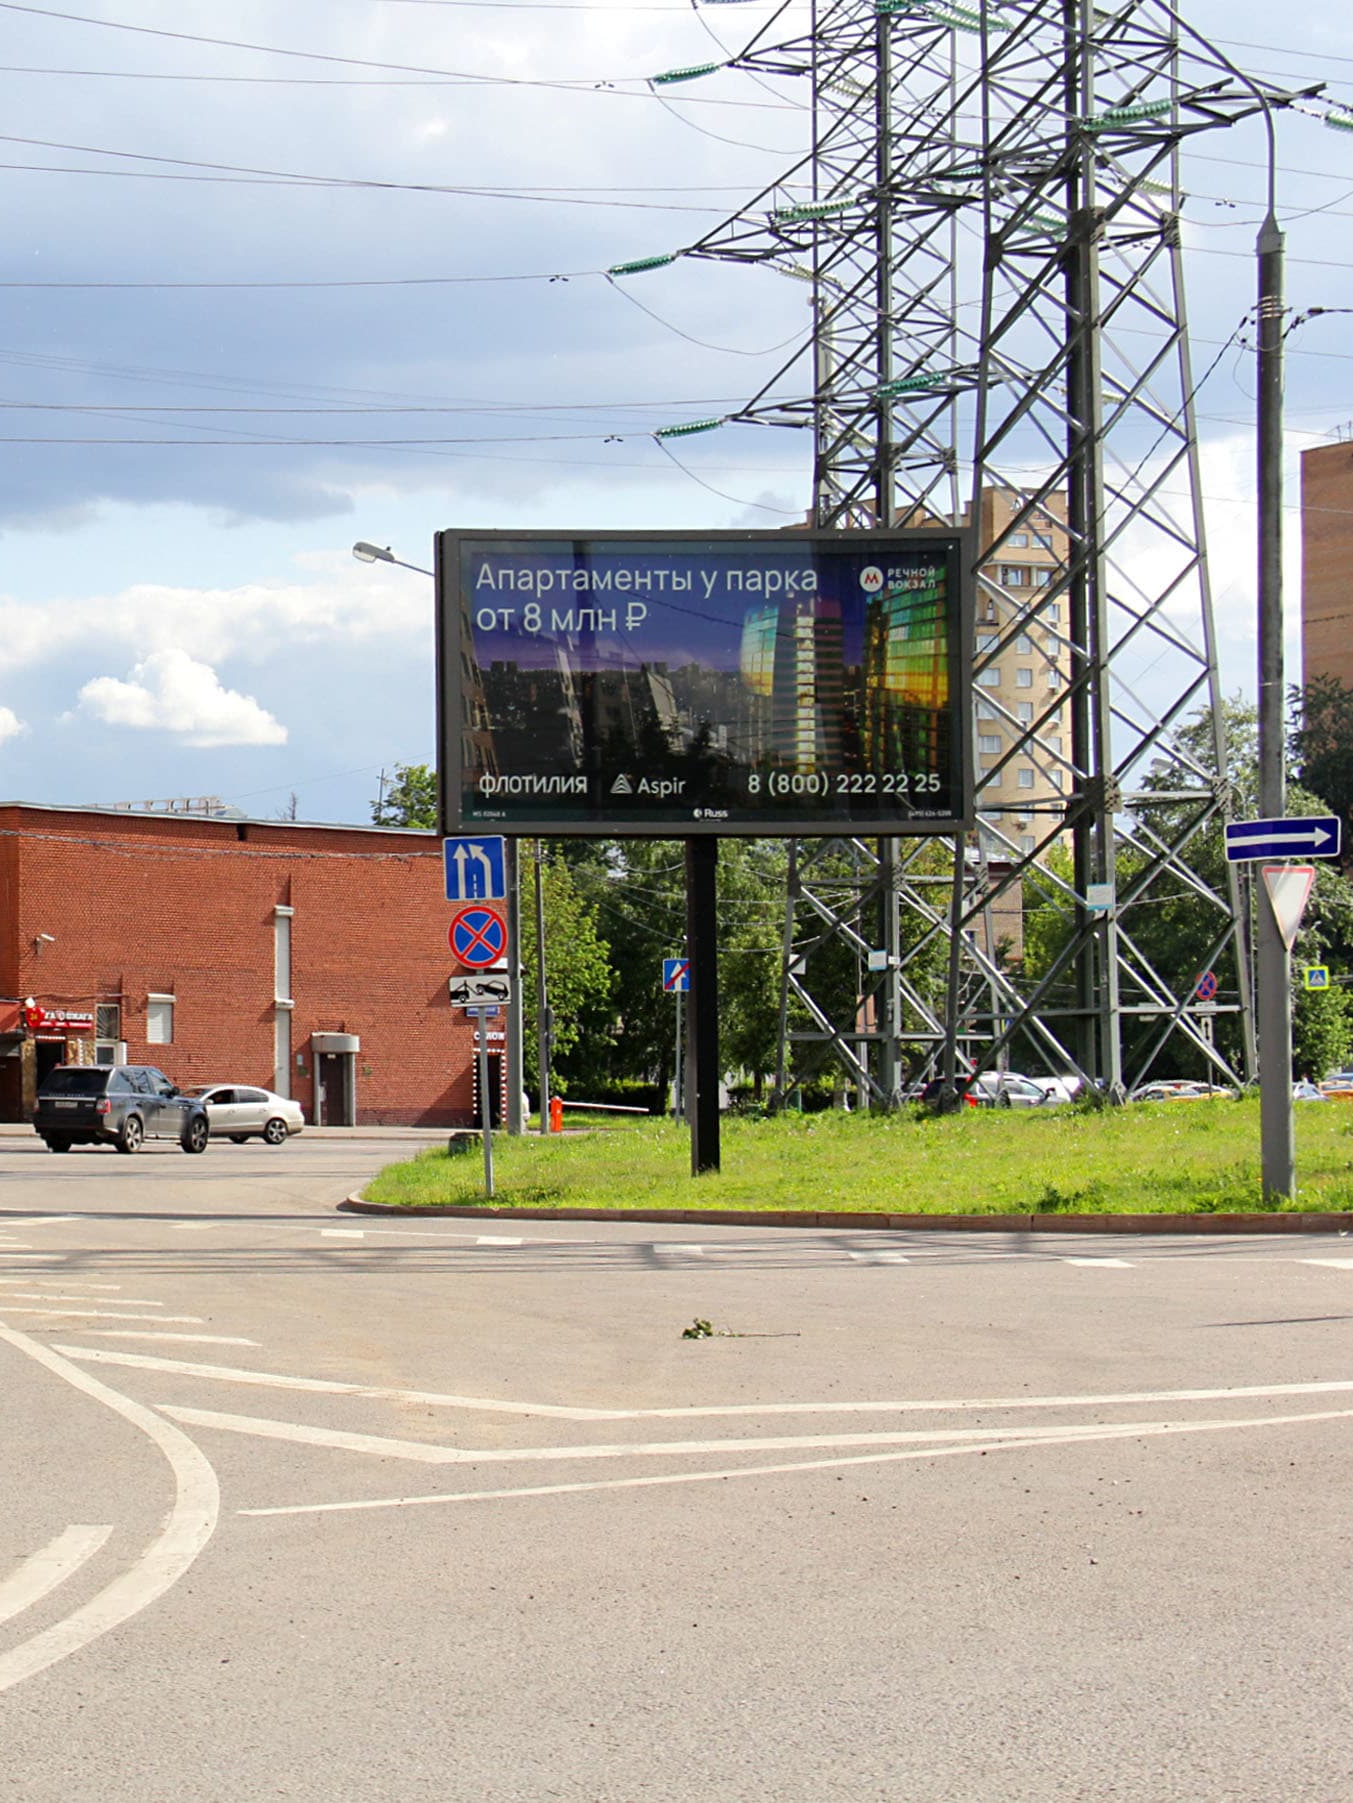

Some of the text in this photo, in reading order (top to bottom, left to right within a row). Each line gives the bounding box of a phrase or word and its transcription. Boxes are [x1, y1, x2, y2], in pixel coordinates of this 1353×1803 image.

[476, 563, 818, 598] Апартаменты у парка
[888, 567, 936, 577] РЕЧНОЙ
[888, 580, 936, 589] ВОКЗАЛ
[476, 608, 514, 631] от
[523, 603, 542, 632] 8
[551, 608, 616, 631] млн
[479, 771, 588, 798] флотилия
[637, 777, 686, 798] Aspir
[748, 771, 941, 796] 8 (800) 222 22 25
[704, 808, 728, 818] Russ
